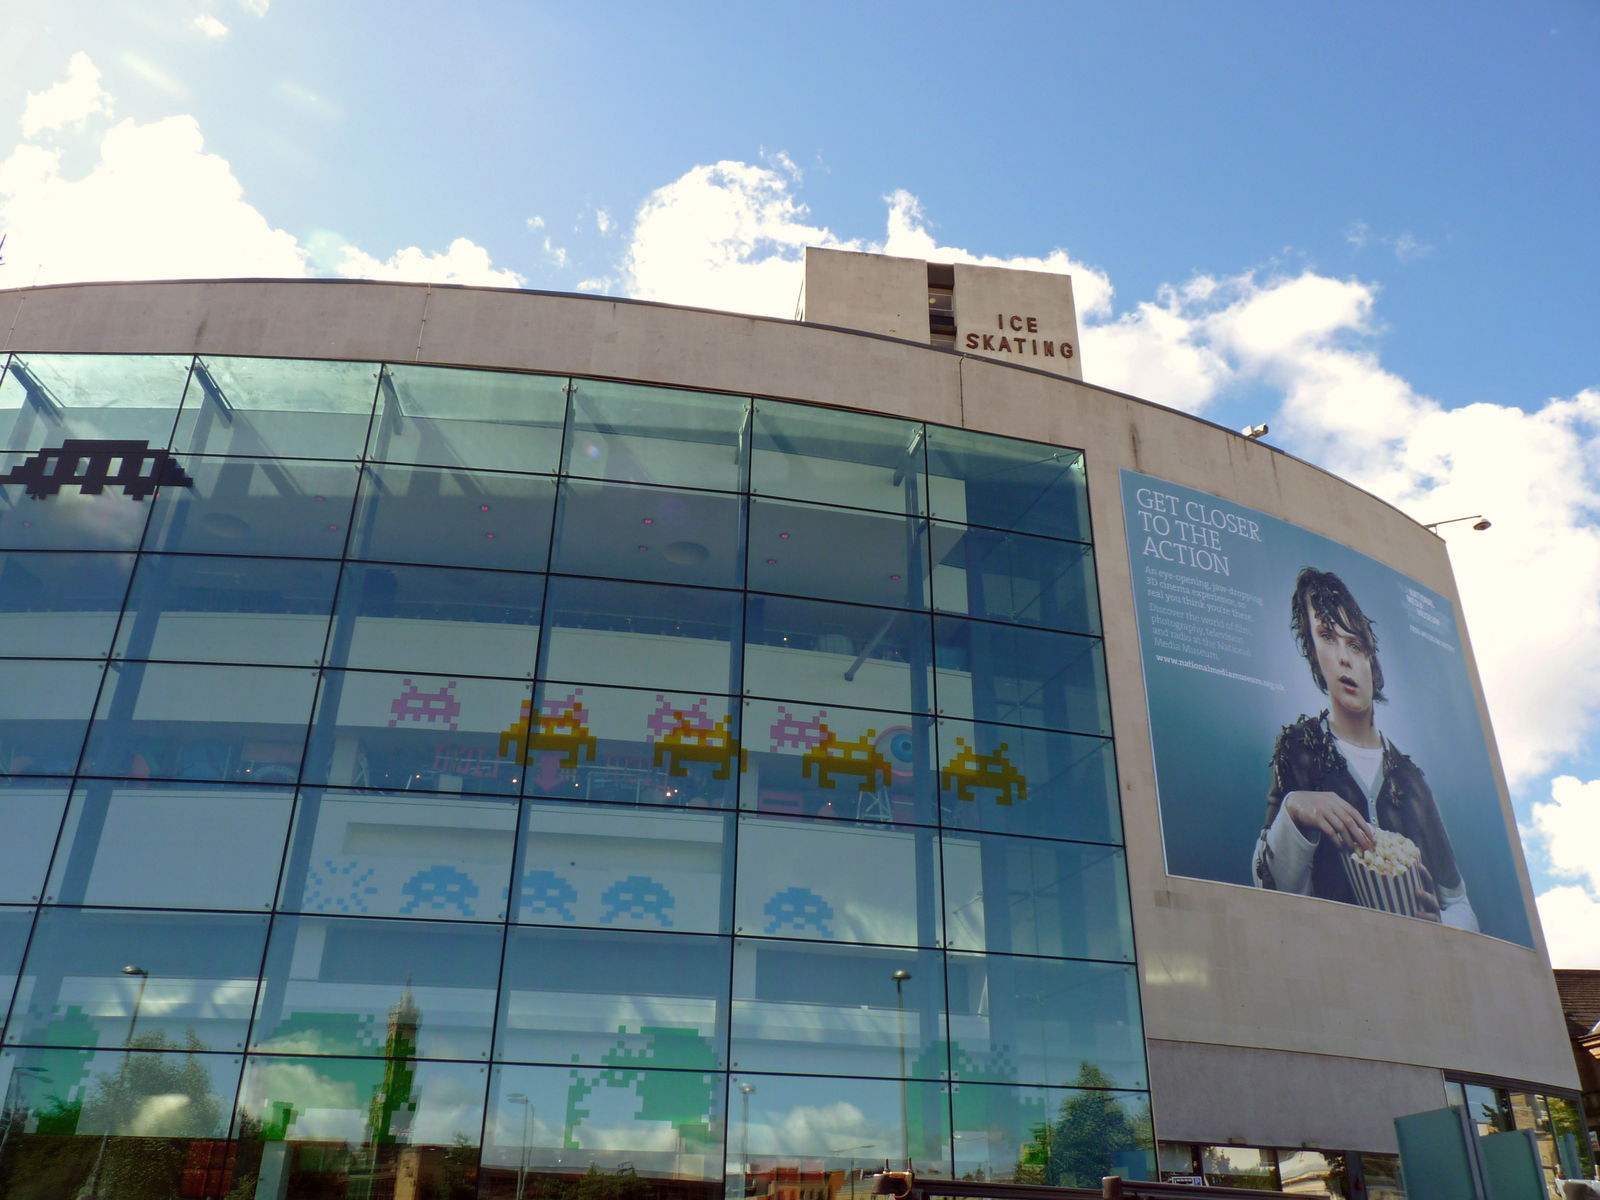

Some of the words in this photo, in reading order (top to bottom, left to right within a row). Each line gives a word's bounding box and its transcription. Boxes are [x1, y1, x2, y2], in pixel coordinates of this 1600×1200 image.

[998, 314, 1038, 333] ICE
[966, 333, 1073, 359] SKATING
[1136, 488, 1179, 516] GET
[1186, 501, 1262, 542] CLOSER
[1138, 510, 1170, 536] TO
[1175, 520, 1222, 551] THE
[1142, 536, 1230, 576] ACTION
[1145, 566, 1157, 576] An
[1146, 577, 1158, 586] 3D
[1159, 581, 1190, 595] cinema
[1147, 588, 1164, 600] real
[1165, 593, 1182, 604] you
[1182, 595, 1206, 610] think
[1149, 602, 1185, 619] Discover
[1186, 610, 1200, 622] the
[1200, 616, 1225, 630] world
[1152, 626, 1170, 638] and
[1154, 637, 1181, 651] Media
